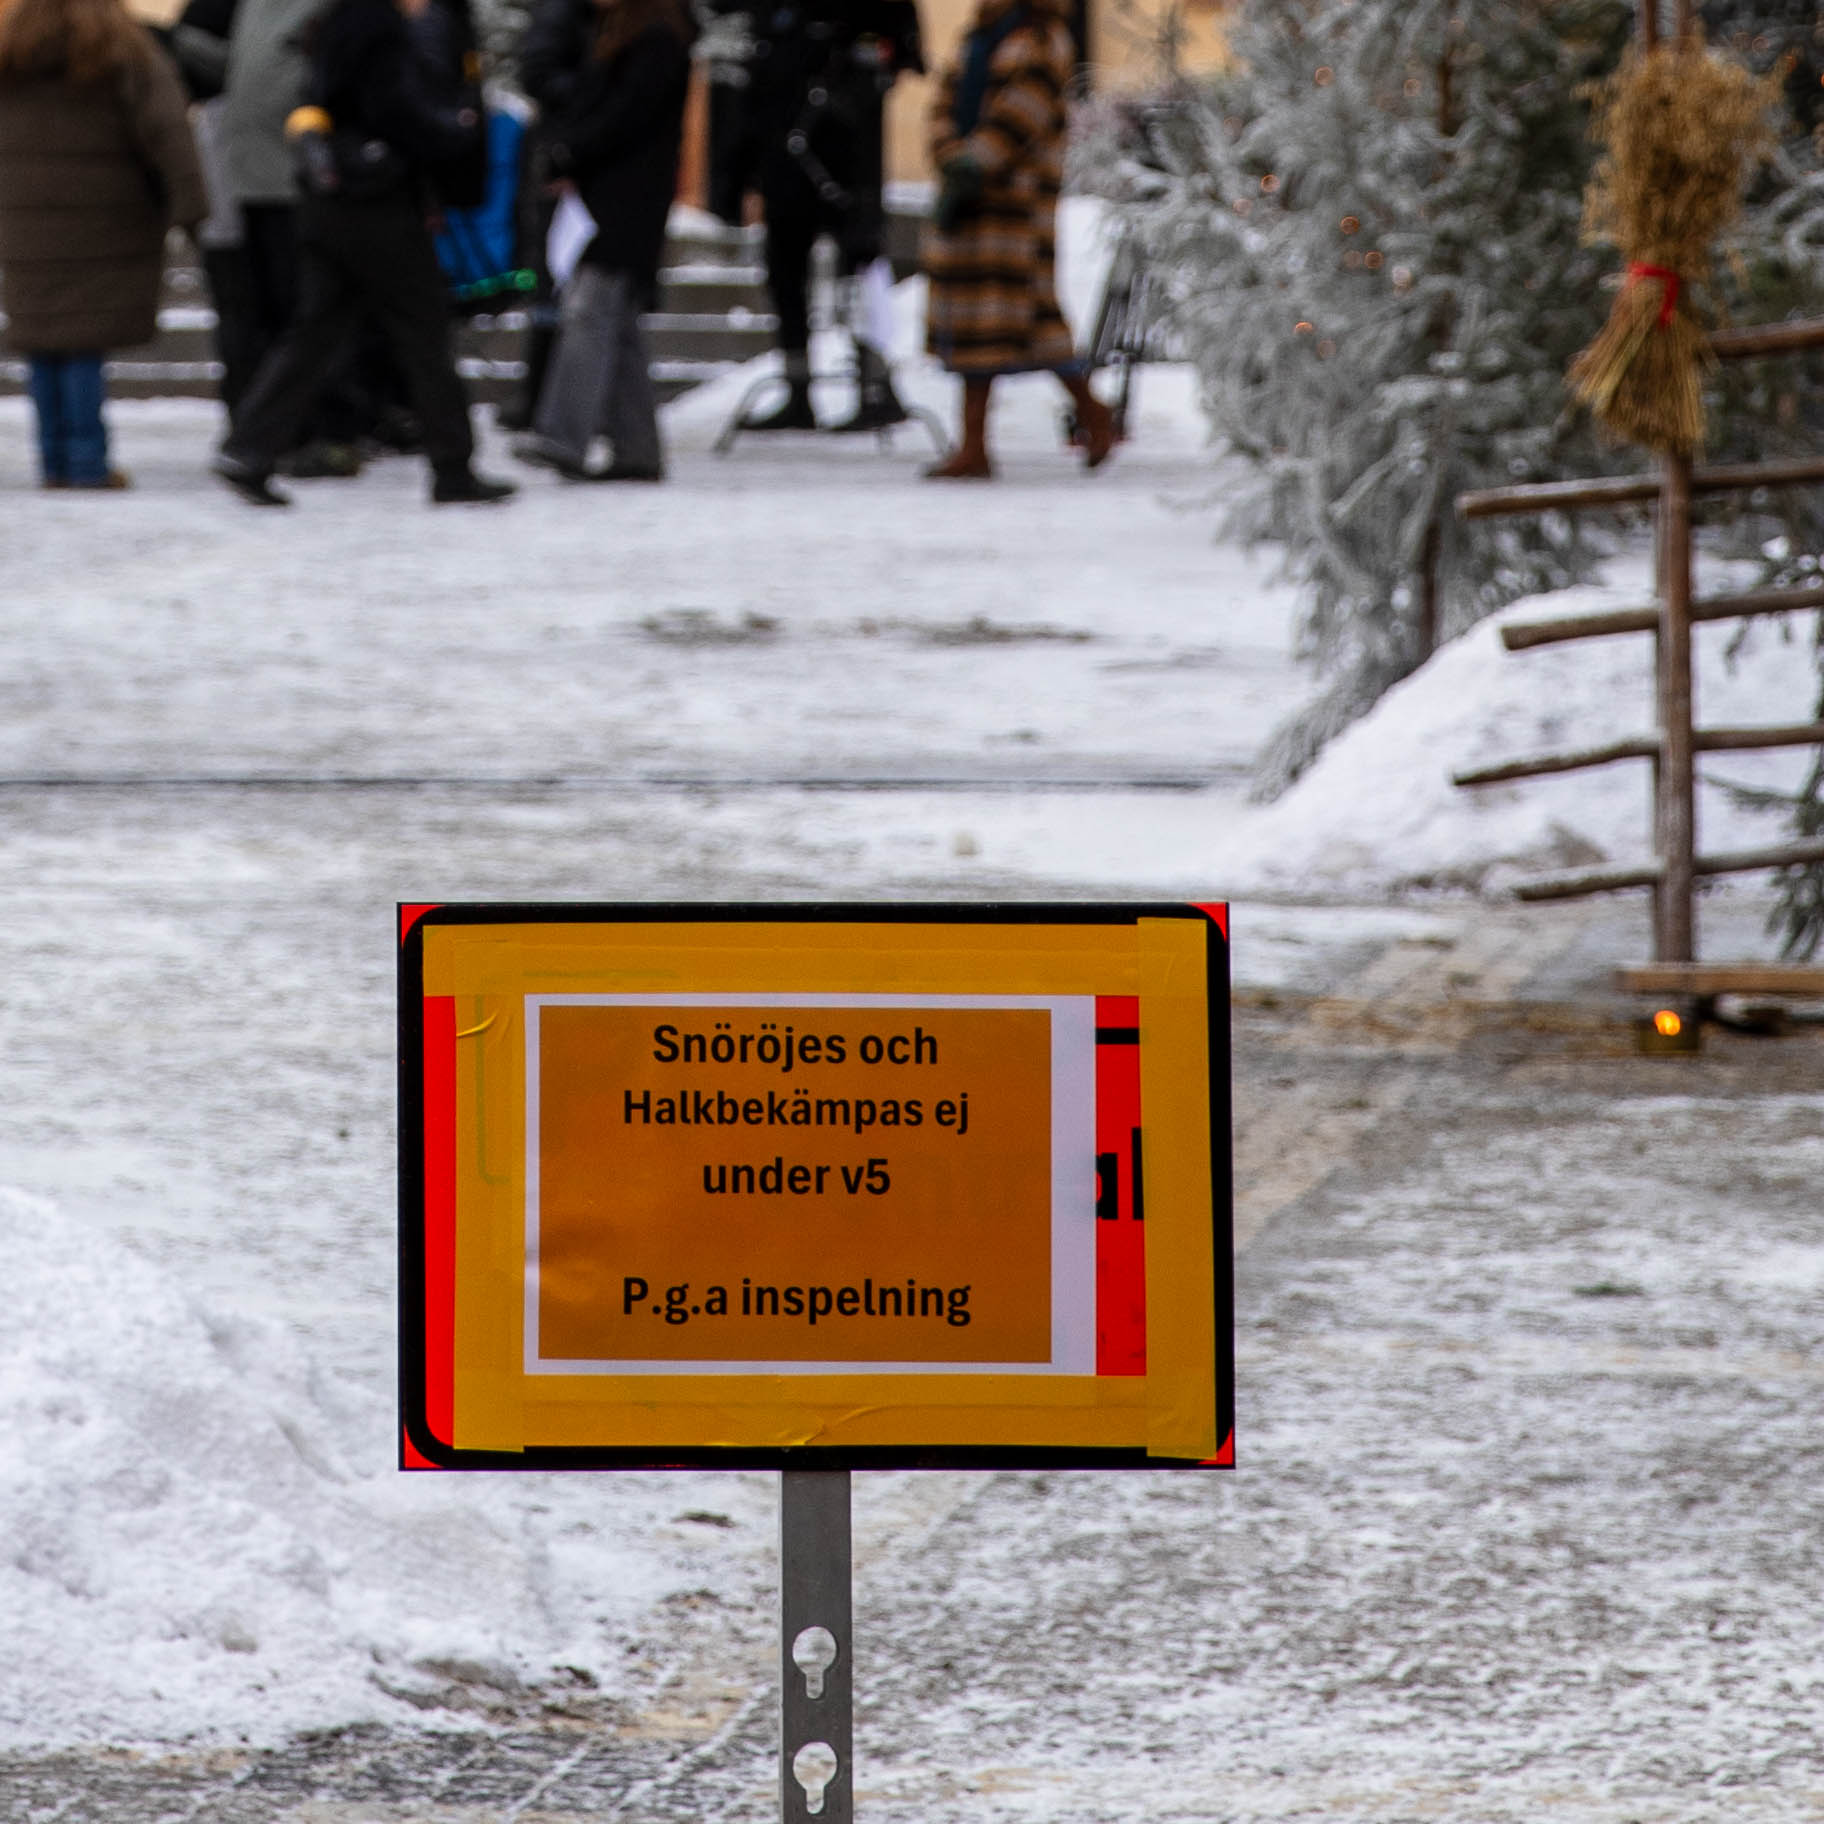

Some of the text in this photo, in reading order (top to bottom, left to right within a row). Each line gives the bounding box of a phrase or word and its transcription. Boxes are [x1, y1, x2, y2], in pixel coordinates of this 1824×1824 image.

[652, 1023, 939, 1073] Snöröjes och
[623, 1089, 969, 1136] Halkbekämpas ej
[702, 1156, 892, 1196] under v5
[622, 1276, 972, 1328] P.g.a inspelning
